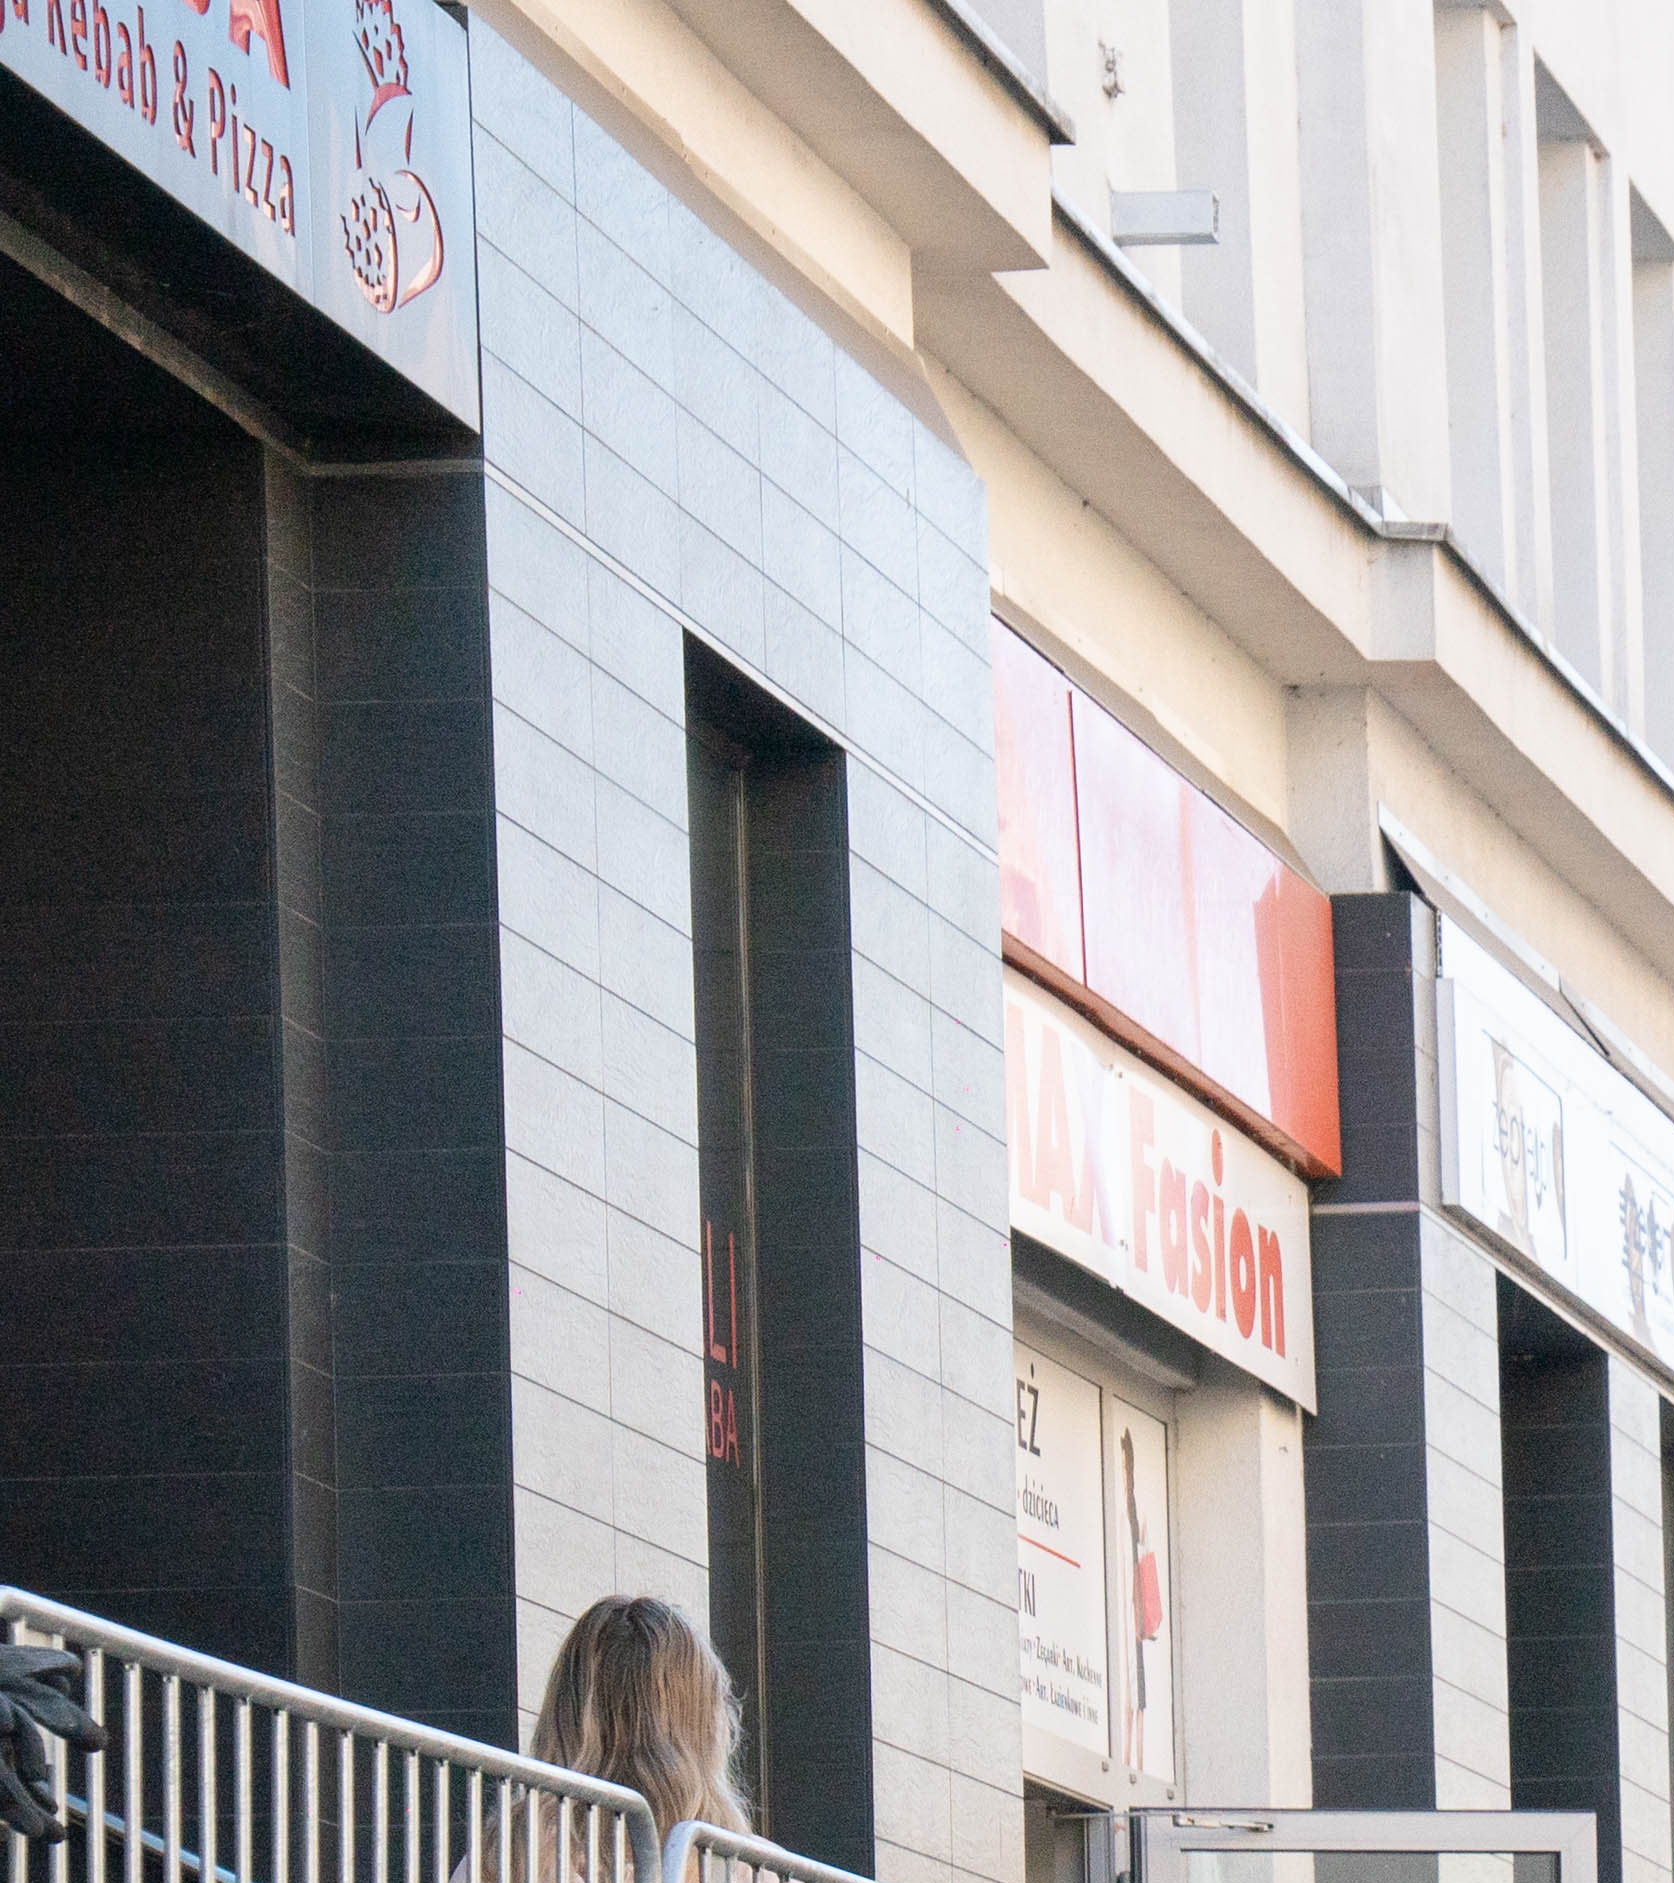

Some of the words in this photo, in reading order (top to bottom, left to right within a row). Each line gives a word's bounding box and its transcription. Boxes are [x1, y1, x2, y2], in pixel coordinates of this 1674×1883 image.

[173, 40, 196, 158] &
[208, 66, 296, 237] Pizza
[1129, 1083, 1287, 1360] Fasion
[706, 1379, 739, 1469] BA
